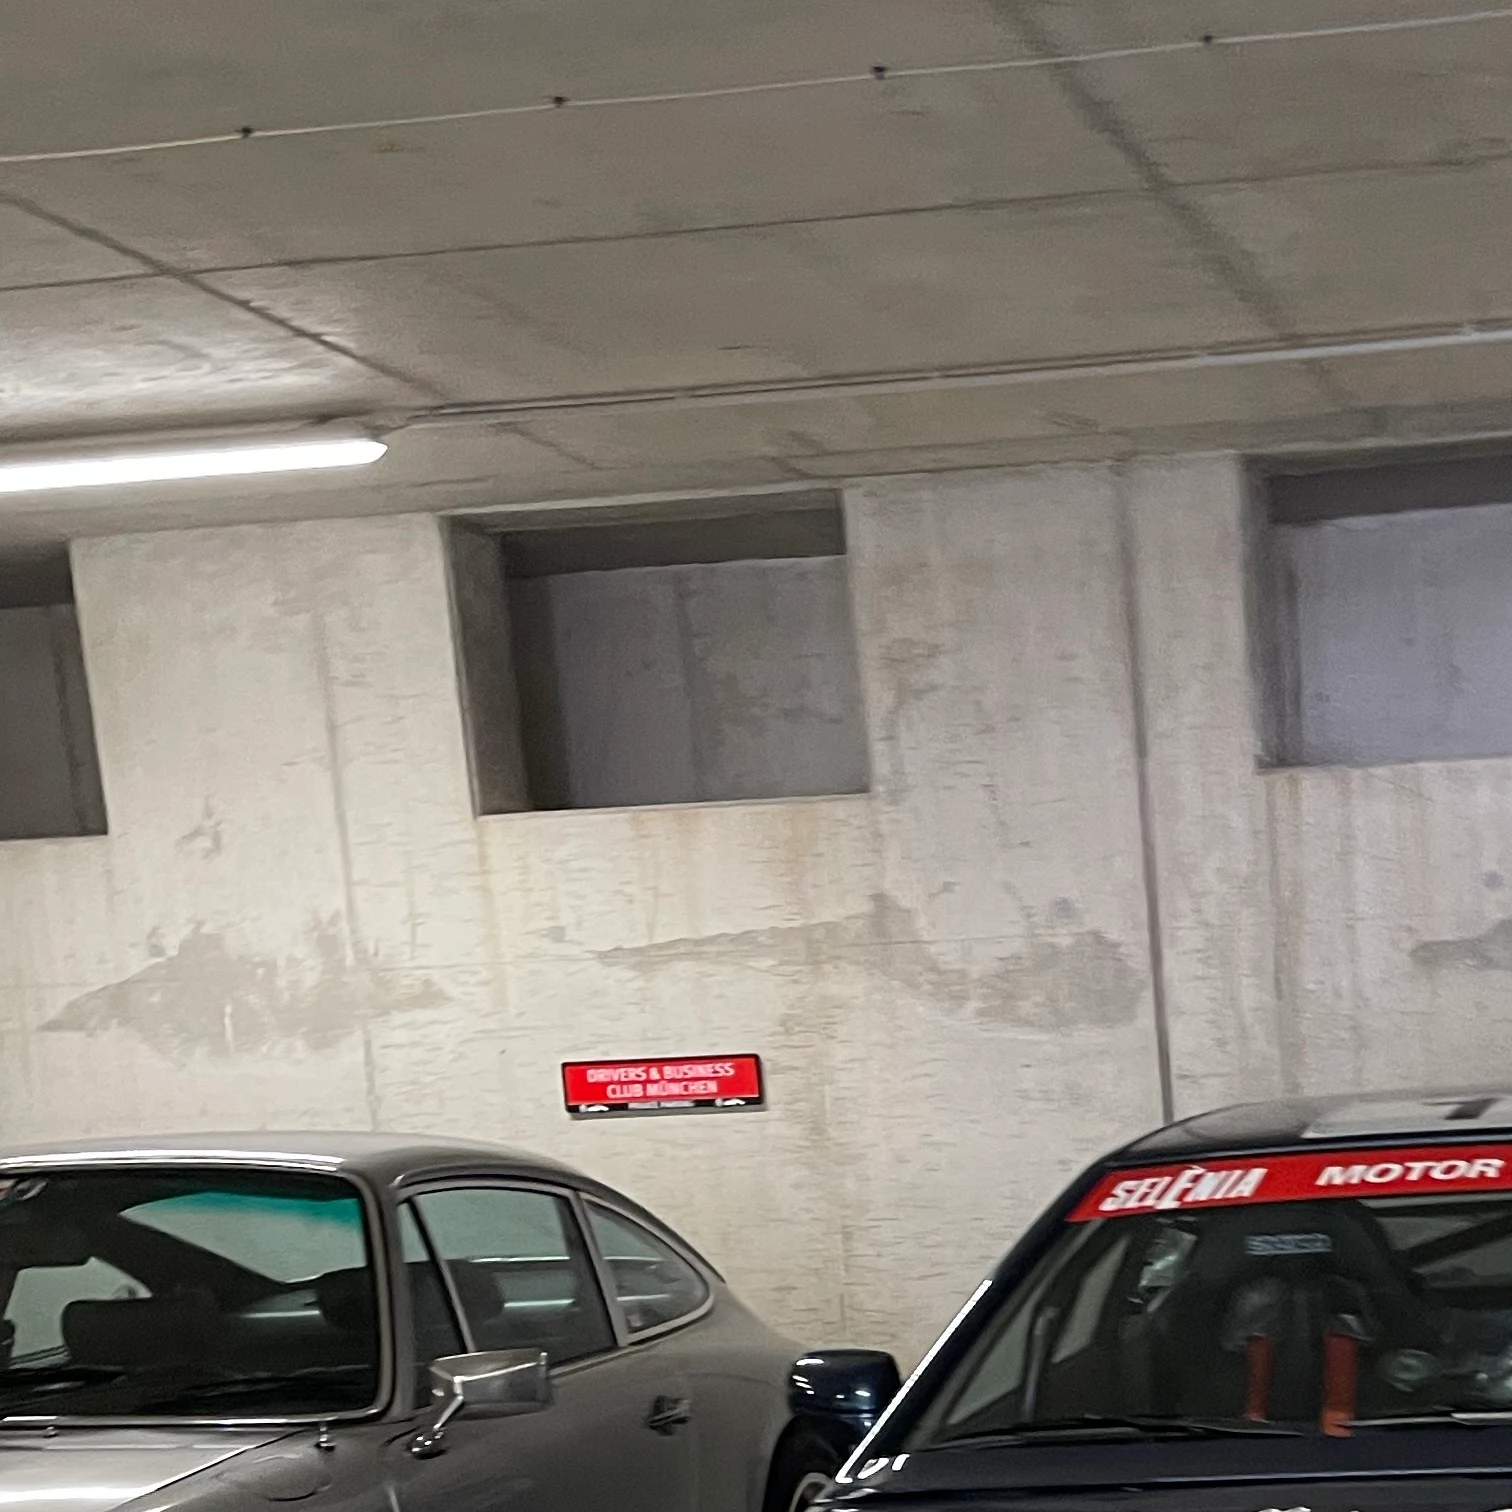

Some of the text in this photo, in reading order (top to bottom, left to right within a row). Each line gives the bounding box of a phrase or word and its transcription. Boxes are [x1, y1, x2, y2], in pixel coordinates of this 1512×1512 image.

[586, 1062, 735, 1083] DRIVERS & BUSINESS
[606, 1079, 719, 1098] CLUB MÜNCHEN
[1314, 1157, 1504, 1187] MOTOR
